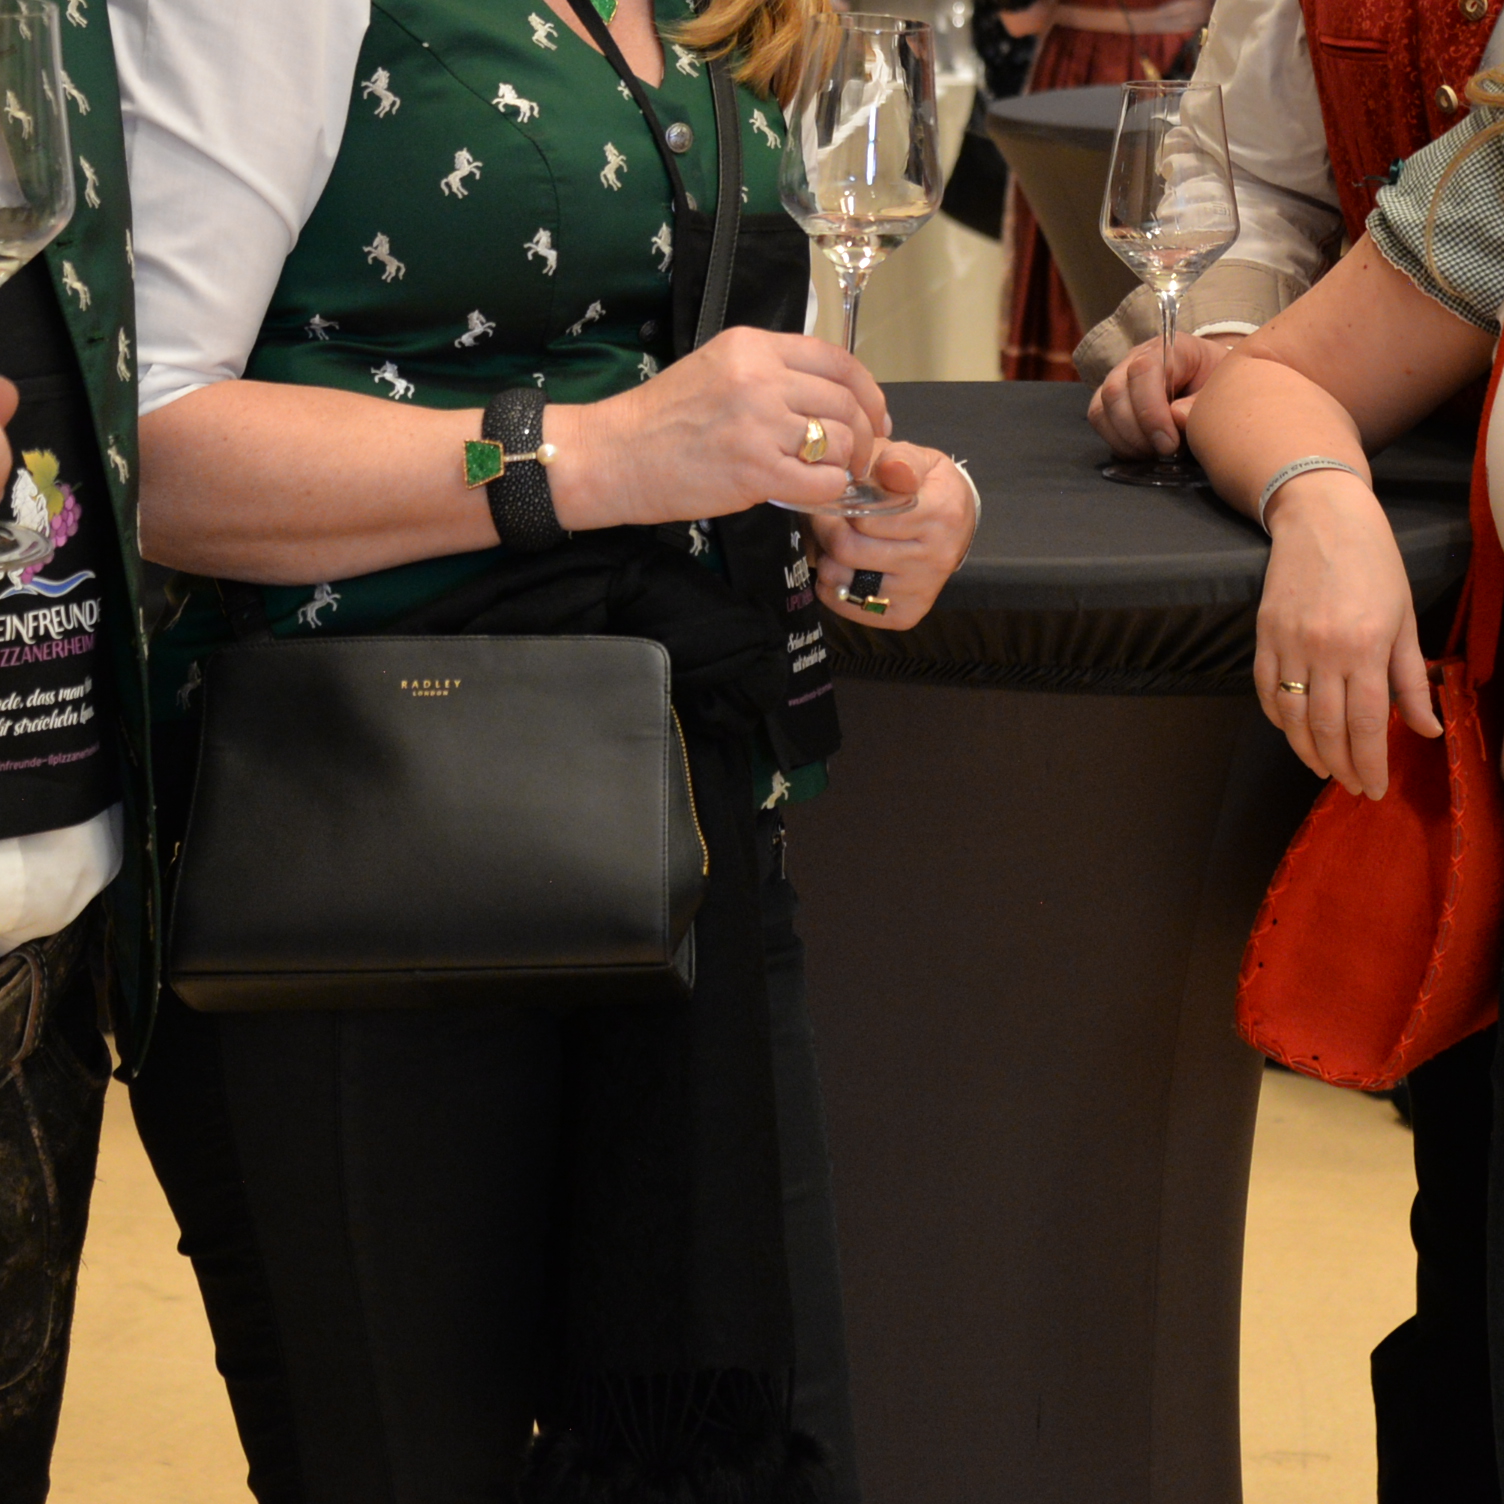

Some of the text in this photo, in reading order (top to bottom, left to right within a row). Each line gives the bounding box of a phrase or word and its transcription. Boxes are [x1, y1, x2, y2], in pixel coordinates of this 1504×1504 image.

[401, 680, 461, 689] RADLEY
[26, 687, 56, 708] dass
[58, 685, 84, 702] man
[13, 705, 79, 736] streicheln
